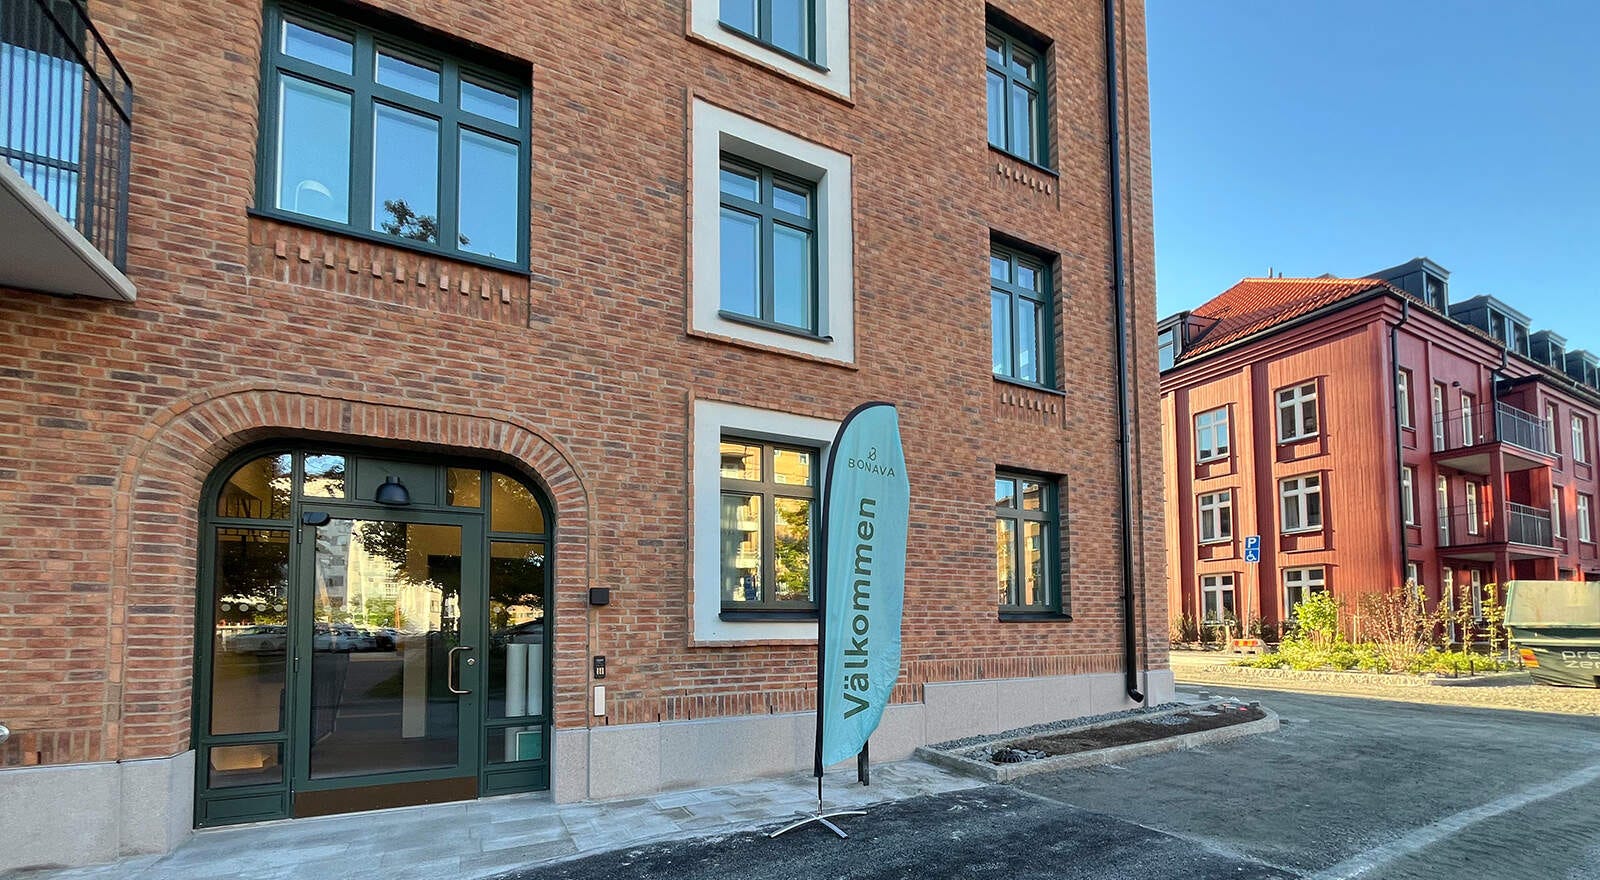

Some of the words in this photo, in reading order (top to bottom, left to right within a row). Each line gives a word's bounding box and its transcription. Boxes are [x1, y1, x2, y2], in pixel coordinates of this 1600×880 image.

[848, 457, 895, 477] BONAVA
[1247, 537, 1257, 549] P
[843, 497, 876, 719] Välkommen
